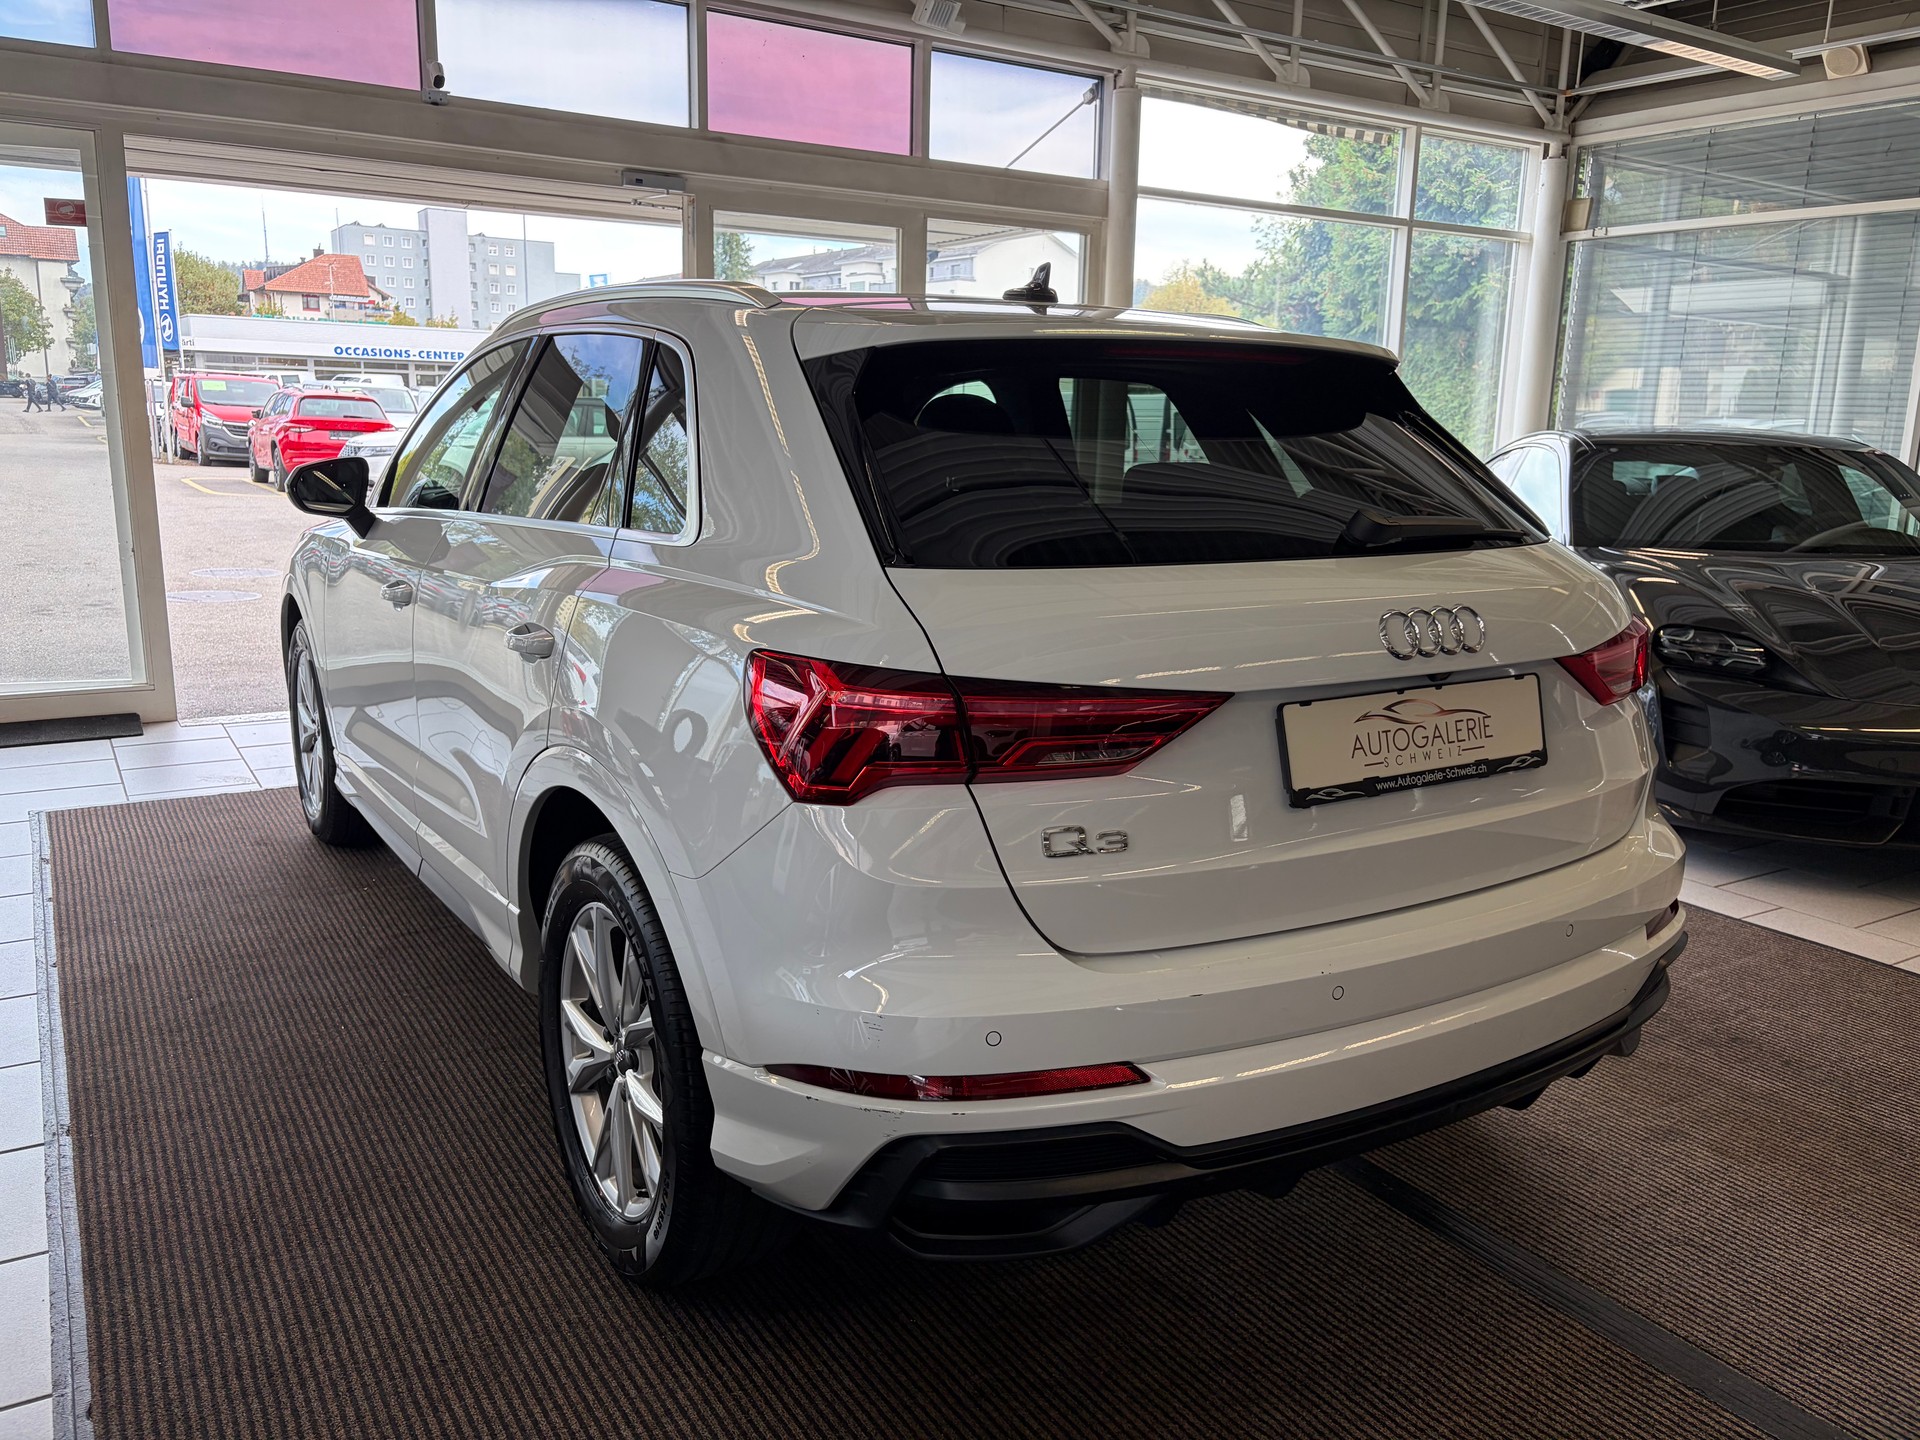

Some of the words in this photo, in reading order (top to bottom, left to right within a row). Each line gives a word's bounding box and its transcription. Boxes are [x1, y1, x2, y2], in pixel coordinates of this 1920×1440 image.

[1351, 714, 1494, 759] AUTOGALERIE
[1383, 745, 1463, 768] SCHWEIZ
[1376, 763, 1488, 791] www.Autogalerie-Schweiz.ch
[1041, 825, 1129, 858] Q3
